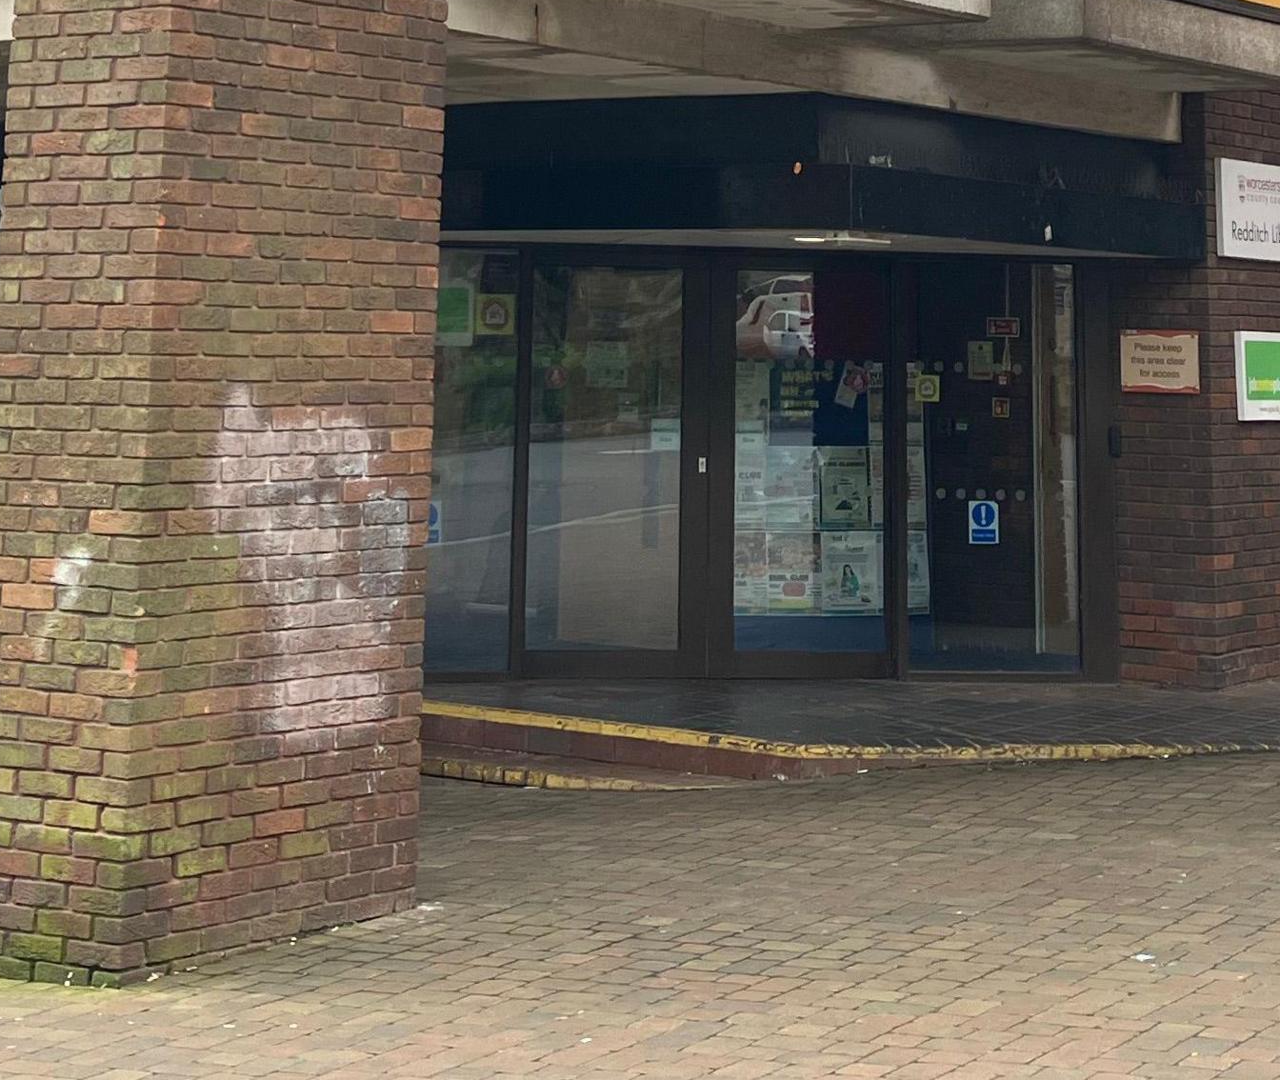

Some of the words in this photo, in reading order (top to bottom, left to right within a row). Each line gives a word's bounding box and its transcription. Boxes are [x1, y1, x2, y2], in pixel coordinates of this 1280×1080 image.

[1231, 220, 1270, 243] Redditch
[1133, 342, 1162, 353] Please
[1162, 344, 1184, 354] keep
[1146, 357, 1165, 365] area
[1166, 358, 1187, 366] clear
[1139, 369, 1151, 377] for
